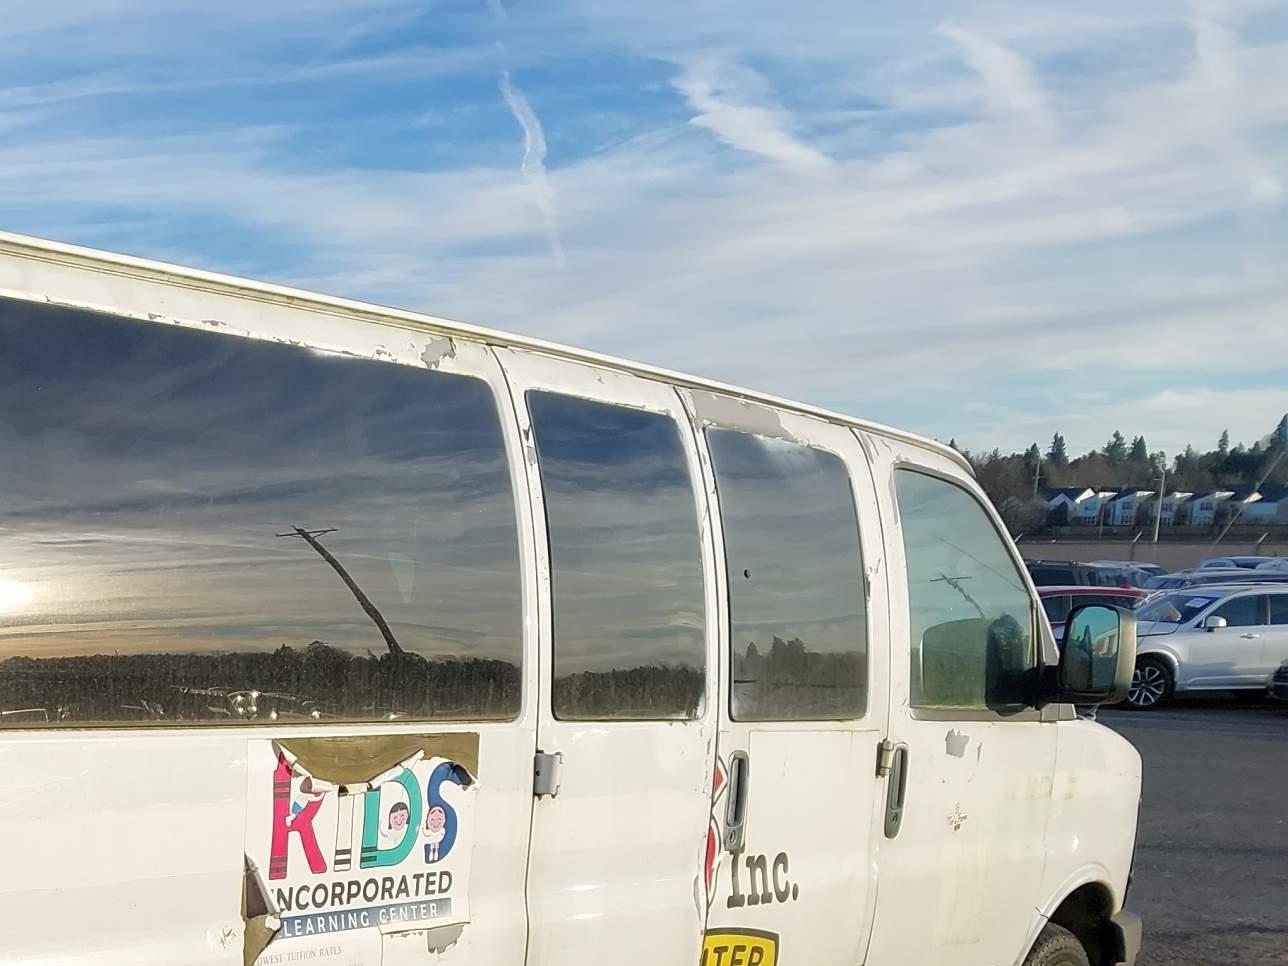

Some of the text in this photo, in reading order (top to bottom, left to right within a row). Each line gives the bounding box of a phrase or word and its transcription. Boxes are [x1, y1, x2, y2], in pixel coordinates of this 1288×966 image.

[268, 751, 471, 881] KIDS
[271, 870, 454, 912] NCORPORATED
[727, 850, 799, 909] Inc.
[283, 902, 439, 938] LEARNING CENTER
[319, 946, 343, 957] RATES
